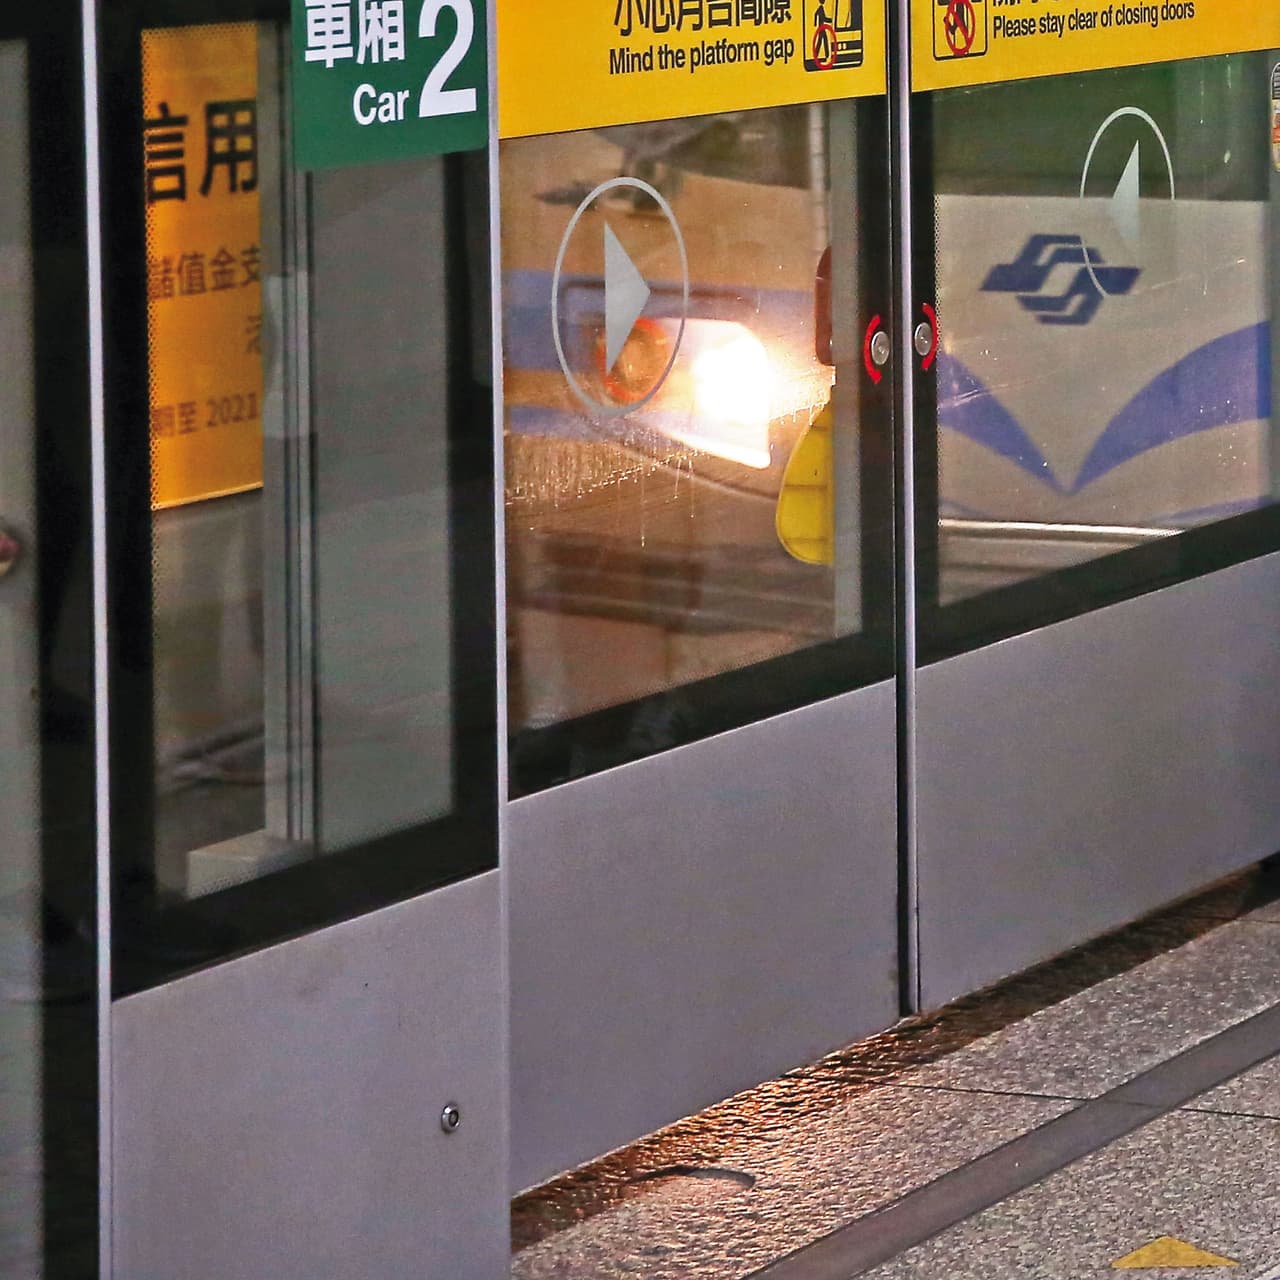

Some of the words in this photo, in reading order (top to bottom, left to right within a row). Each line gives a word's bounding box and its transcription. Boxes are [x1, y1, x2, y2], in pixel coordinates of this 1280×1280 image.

[993, 14, 1036, 39] Please
[1038, 11, 1066, 38] stay
[1068, 7, 1098, 31] clear
[1100, 4, 1113, 27] of
[1116, 1, 1159, 28] closing
[1161, 0, 1195, 21] doors
[609, 45, 653, 75] Mind
[657, 43, 686, 70] the
[690, 37, 759, 74] platform
[763, 37, 795, 66] gap
[353, 83, 410, 126] Car
